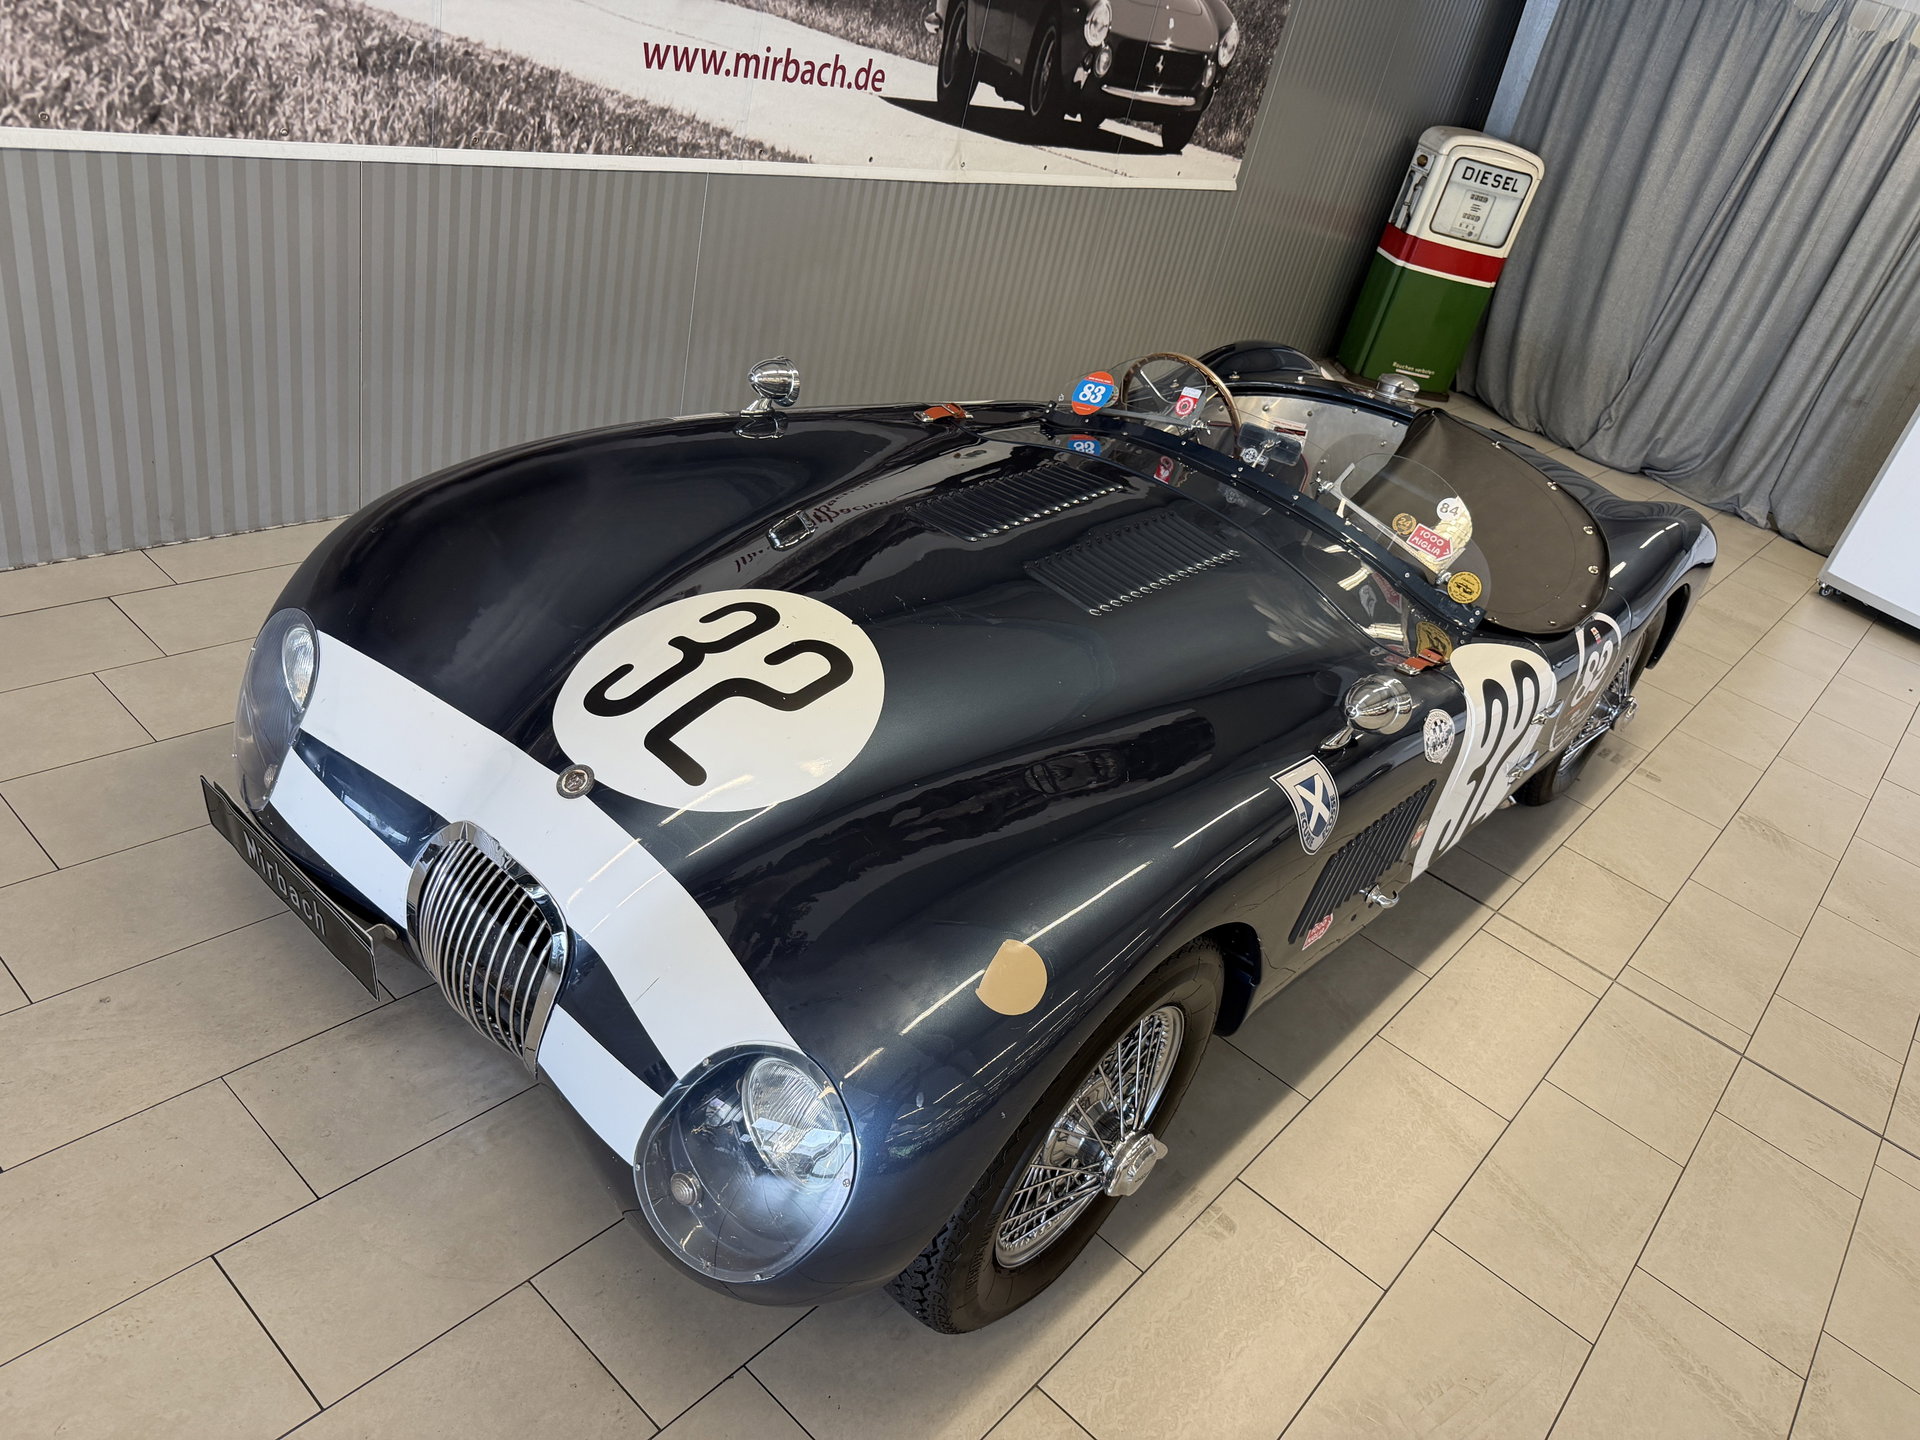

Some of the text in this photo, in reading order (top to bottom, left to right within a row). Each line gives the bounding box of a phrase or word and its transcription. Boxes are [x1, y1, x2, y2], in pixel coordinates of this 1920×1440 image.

[643, 42, 886, 92] www.mirbach.de
[1461, 166, 1519, 193] DIESEL
[1078, 383, 1106, 404] 83
[1440, 502, 1460, 517] 84
[1411, 536, 1441, 557] MIGLIA
[1419, 530, 1445, 546] 1000
[583, 601, 854, 786] 32
[1427, 659, 1540, 870] 32
[243, 829, 327, 937] Mirbach
